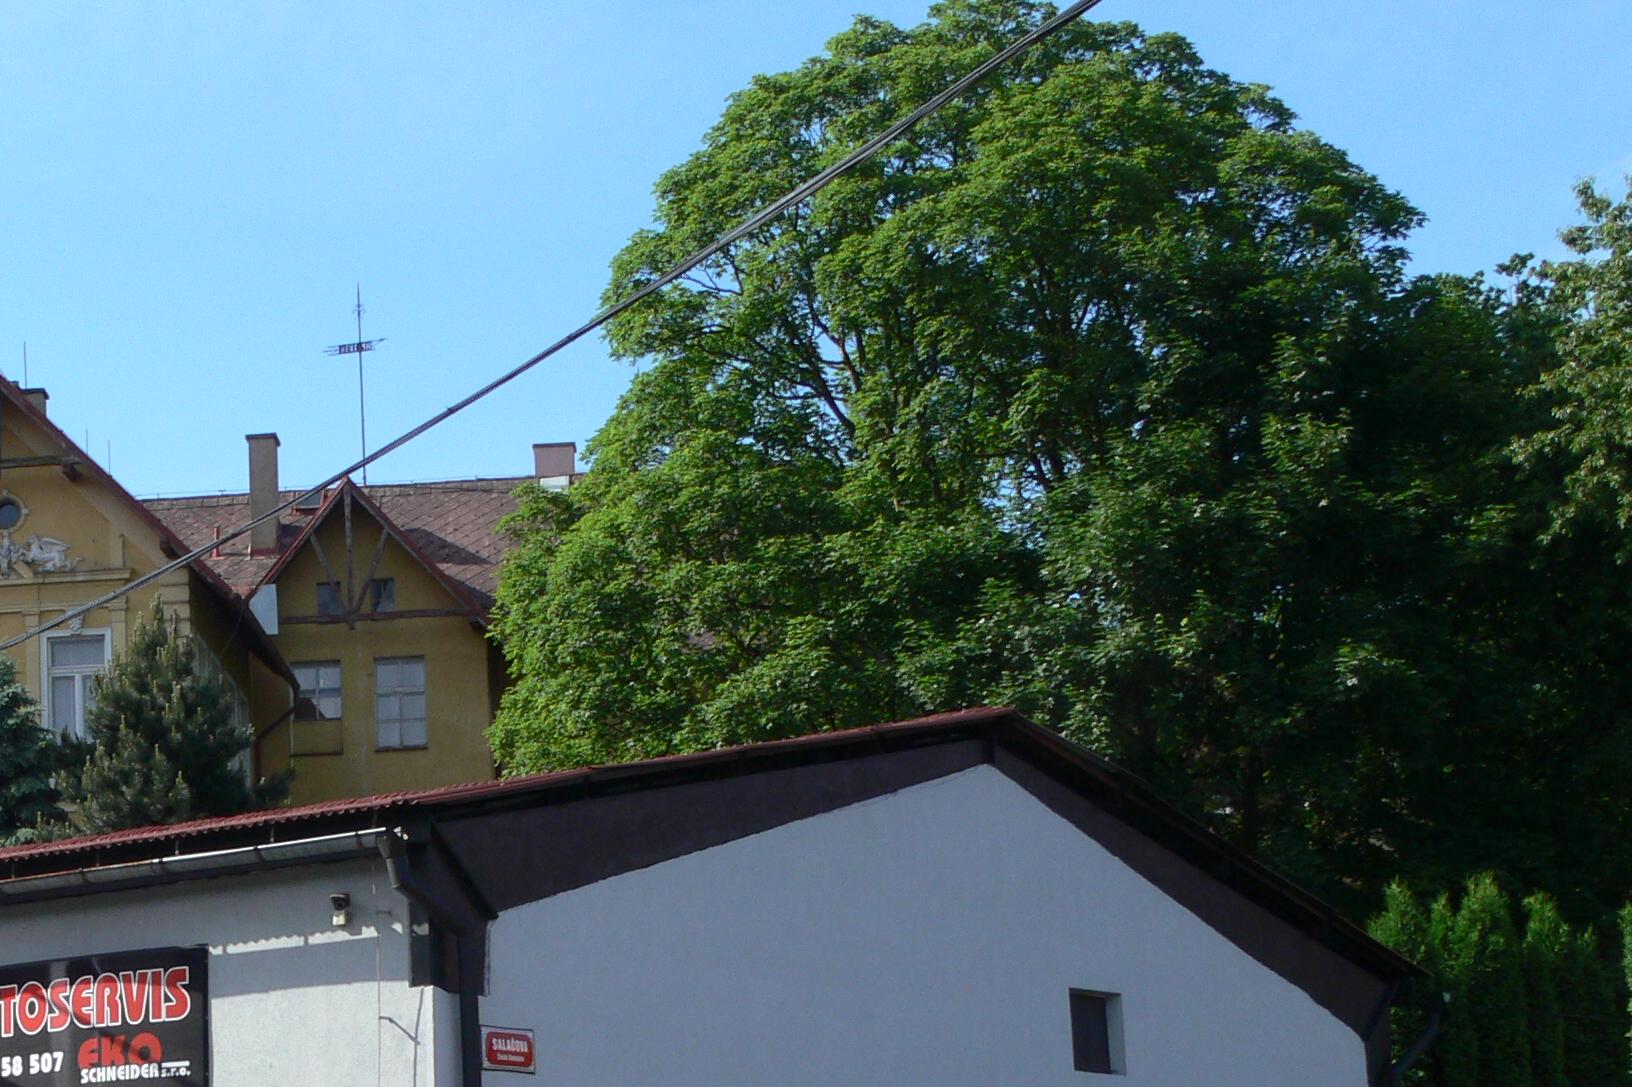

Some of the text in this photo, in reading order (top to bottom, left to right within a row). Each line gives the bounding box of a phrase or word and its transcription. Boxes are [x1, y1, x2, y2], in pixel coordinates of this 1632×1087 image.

[77, 1031, 164, 1069] EKO
[29, 1051, 64, 1075] 507
[80, 1062, 159, 1085] SCHNEIDER
